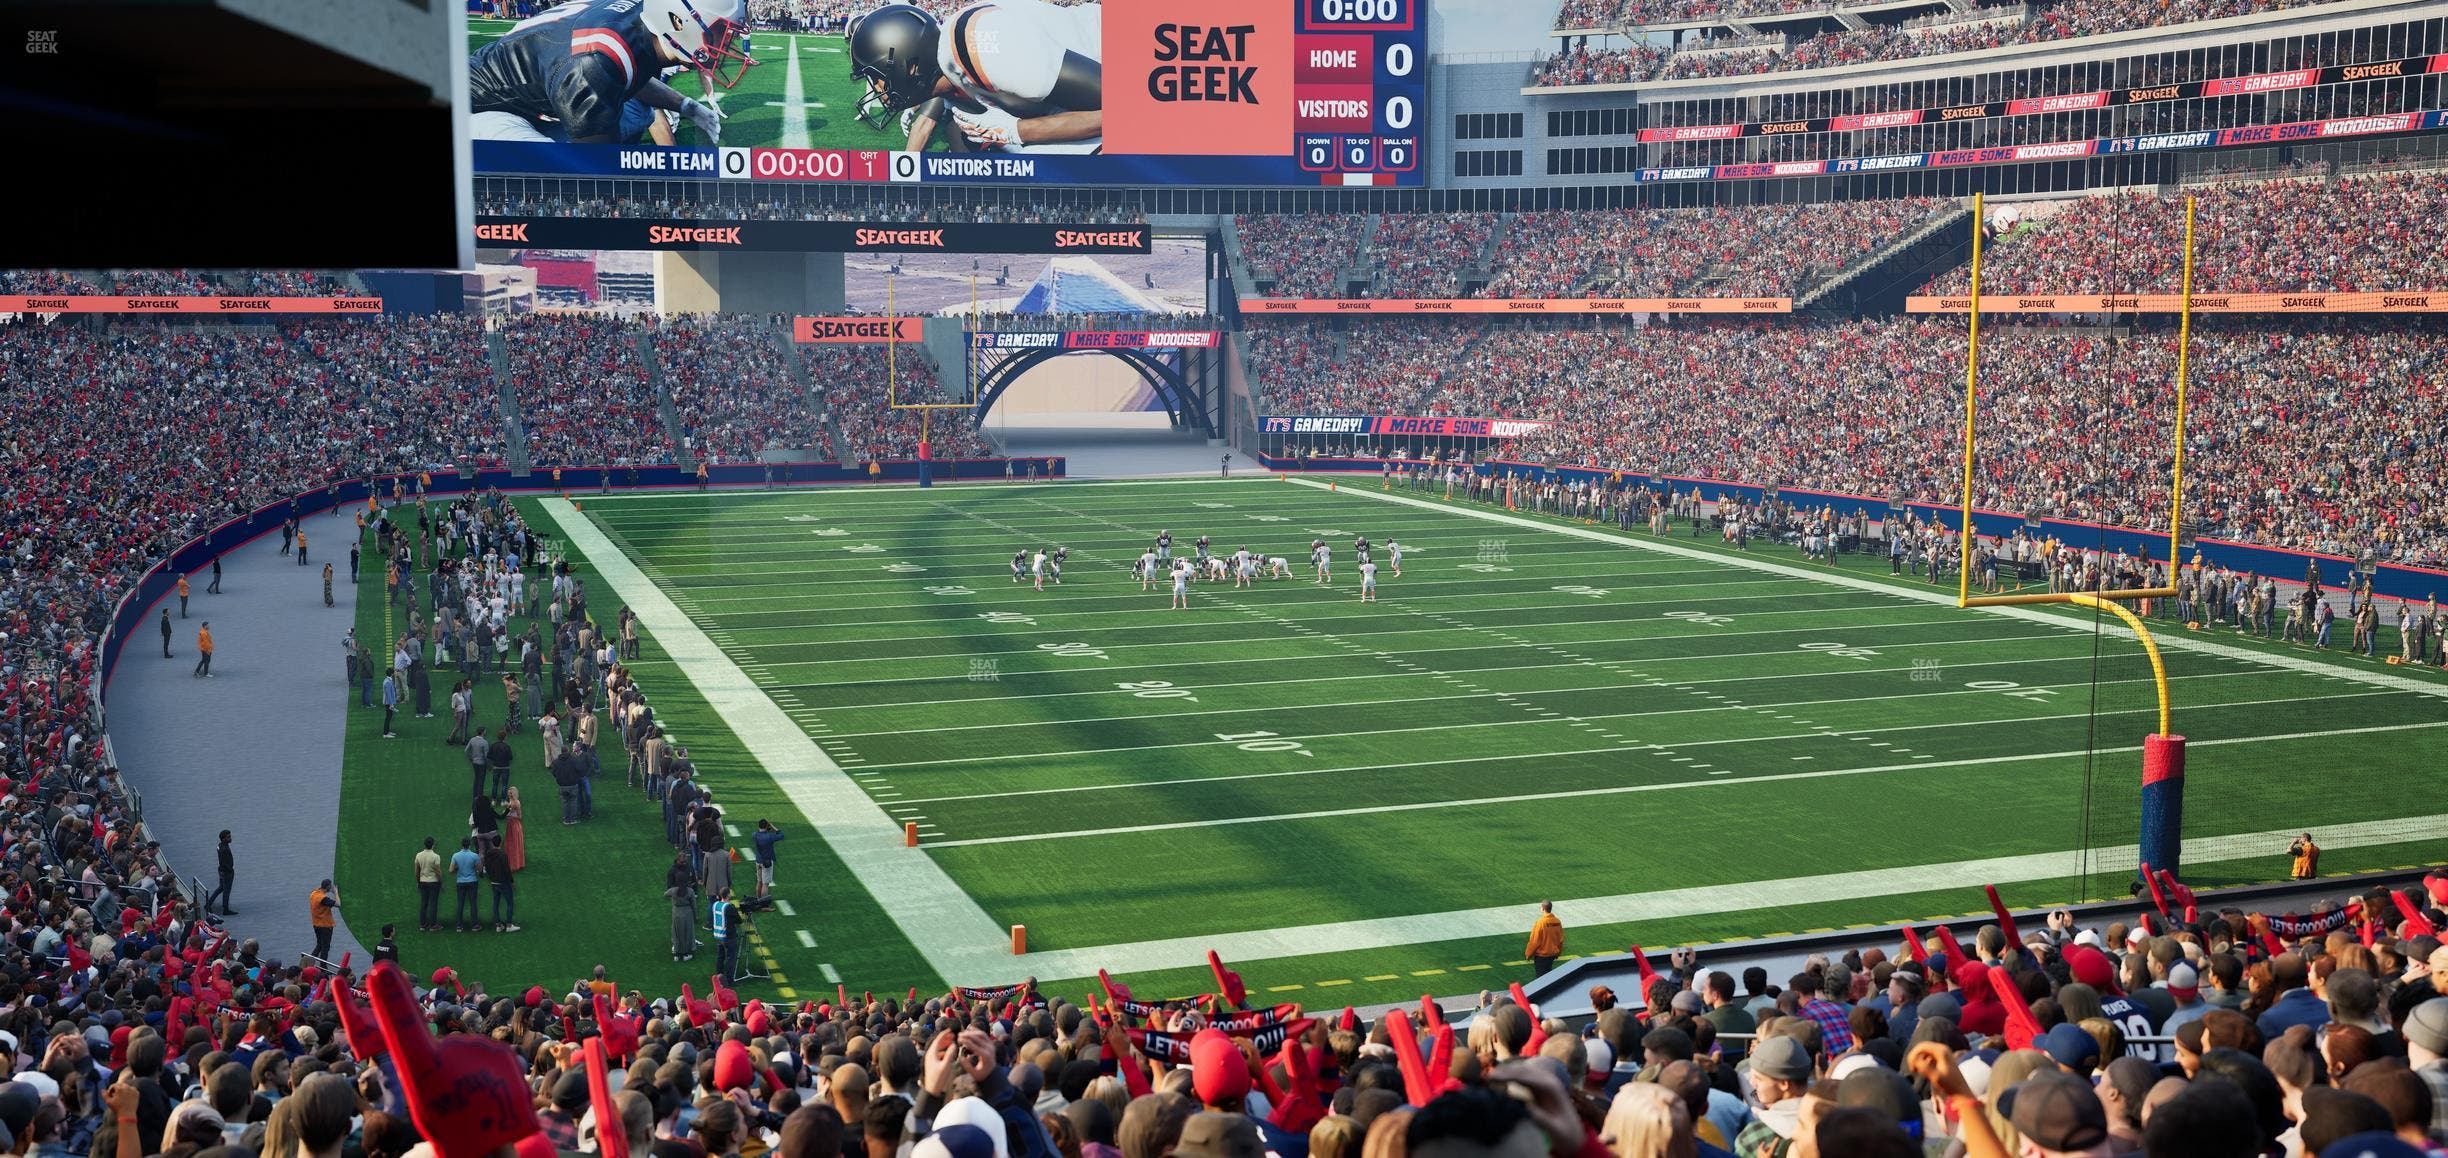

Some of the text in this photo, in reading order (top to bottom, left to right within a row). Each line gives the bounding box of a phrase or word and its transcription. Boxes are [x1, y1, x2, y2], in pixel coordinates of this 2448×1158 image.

[1322, 0, 1398, 21] 0:00
[1154, 23, 1256, 62] SEAT
[1310, 49, 1357, 68] HOME
[1385, 43, 1413, 76] 0
[2342, 61, 2403, 81] SEATGEEK
[1147, 65, 1260, 105] GEEK
[2219, 72, 2307, 93] IT'S GAMEDAY!
[2129, 85, 2180, 103] SEATGEEK
[1297, 99, 1369, 118] VISITORS
[2042, 95, 2098, 111] GAMEDAY!
[1385, 95, 1413, 129] 0
[1862, 112, 1914, 126] GAMEDAY!
[1941, 105, 1986, 121] SEATGEEK
[1675, 126, 1732, 139] GAMEDAY!
[1761, 121, 1809, 135] SEATGEEK
[2138, 132, 2211, 150] GAMEDAY!
[2230, 127, 2272, 143] MAKE
[2278, 123, 2319, 139] SOME
[620, 150, 714, 171] HOME TEAM
[726, 150, 745, 175] 0
[757, 151, 844, 177] 00:00
[860, 151, 878, 160] QRT
[1311, 147, 1326, 164] 0
[1351, 147, 1365, 164] 0
[1390, 147, 1405, 164] 0
[1861, 155, 1923, 170] GAMEDAY!
[1940, 151, 1975, 164] MAKE
[1979, 149, 2014, 162] SOME
[865, 161, 873, 177] 1
[896, 154, 915, 178] 0
[927, 158, 1035, 177] VISITORS TEAM
[1661, 167, 1710, 180] GAMEDAY!
[1724, 166, 1748, 177] MAKE
[1751, 165, 1773, 176] SOME
[649, 225, 742, 245] SEATGEEK
[855, 228, 944, 247] SEATGEEK
[1055, 230, 1143, 248] SEATGEEK
[26, 299, 70, 310] SEATGEEK
[128, 299, 180, 310] SEATGEEK
[220, 299, 271, 310] SEATGEEK
[333, 299, 381, 310] SEATGEEK
[1265, 302, 1297, 310] SEATGEEK
[1337, 302, 1371, 310] SEATGEEK
[1415, 302, 1452, 310] SEATGEEK
[1509, 302, 1545, 310] SEATGEEK
[1589, 301, 1625, 310] SEATGEEK
[1667, 301, 1701, 310] SEATGEEK
[1743, 301, 1778, 310] SEATGEEK
[2019, 299, 2056, 309] SEATGEEK
[2101, 298, 2139, 309] SEATGEEK
[2190, 298, 2230, 308] SEATGEEK
[2282, 297, 2326, 308] SEATGEEK
[2383, 296, 2429, 308] SEATGEEK
[812, 320, 905, 339] SEATGEEK
[997, 333, 1058, 347] GAMEDAY!
[1076, 334, 1109, 346] MAKE
[1114, 334, 1145, 346] SOME
[1266, 418, 1291, 432] IT'S
[1294, 417, 1362, 433] GAMEDAY!
[1389, 419, 1445, 433] MAKE
[1453, 420, 1488, 434] SOME
[1036, 642, 1105, 658] 30
[1113, 680, 1192, 698] 20
[1214, 730, 1304, 752] 10
[1144, 1032, 1190, 1058] LET'S
